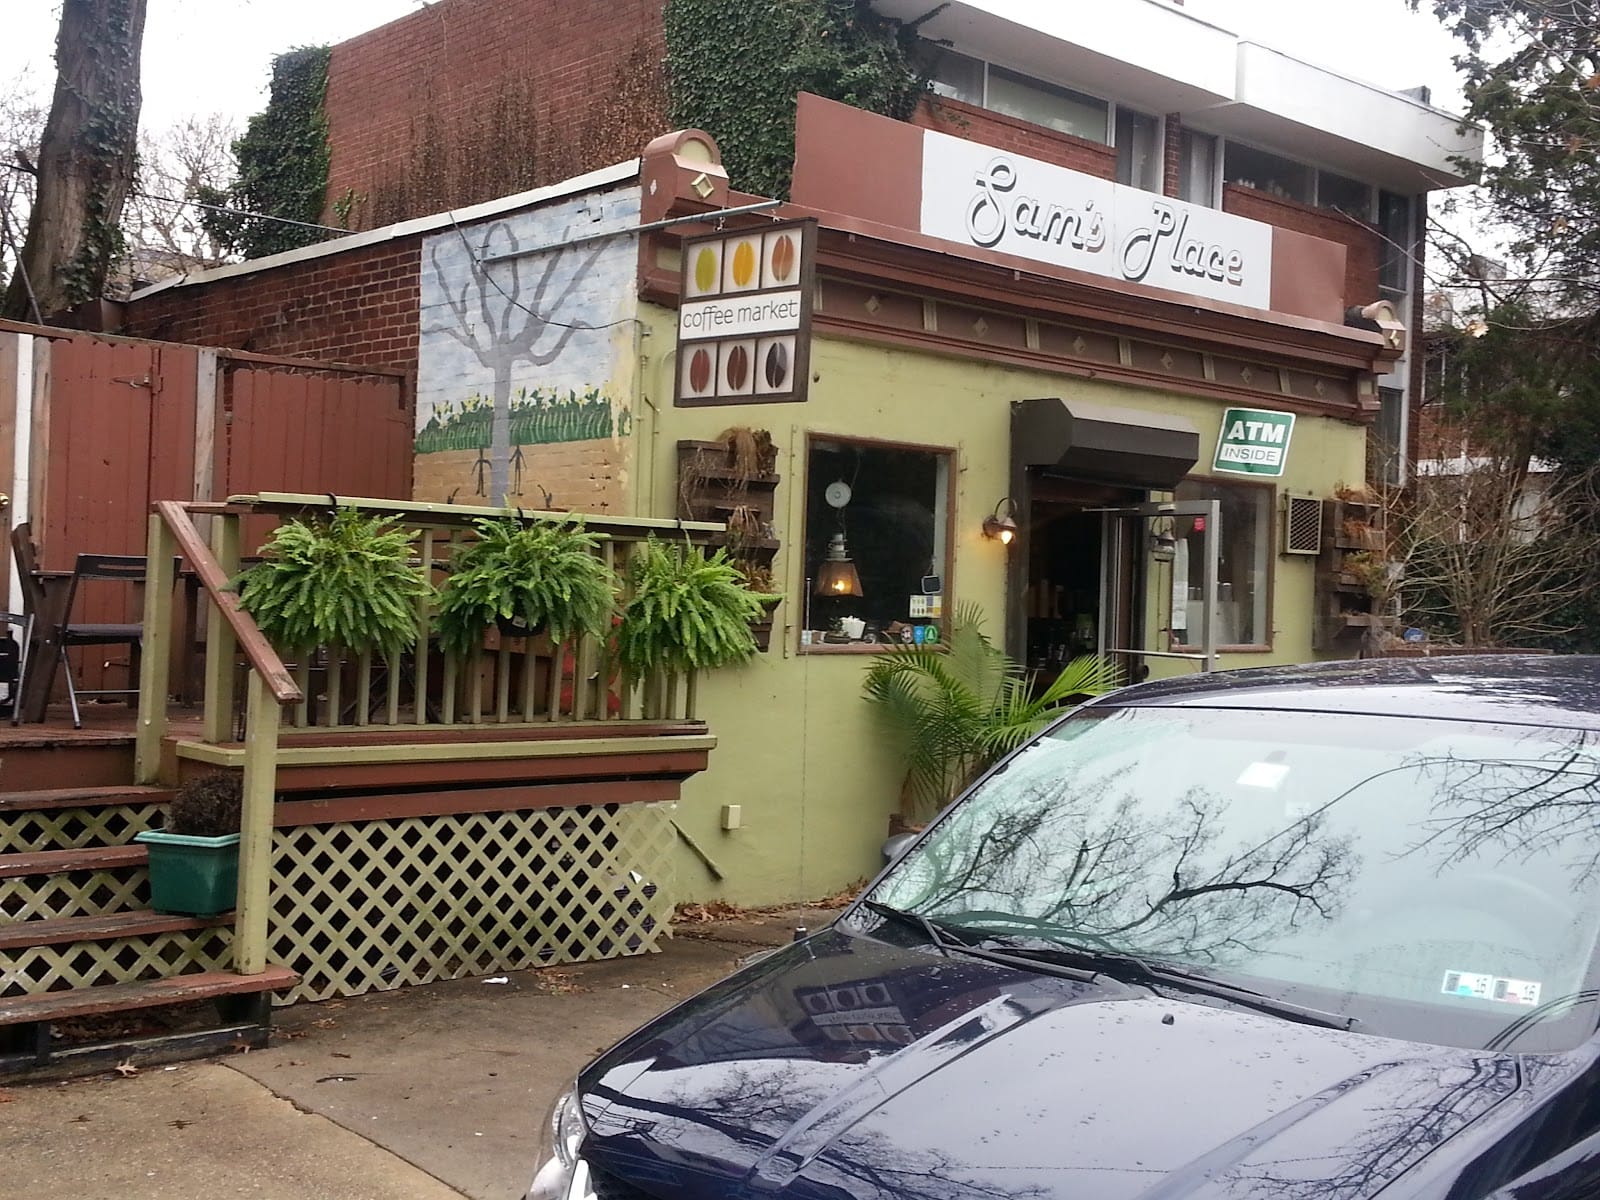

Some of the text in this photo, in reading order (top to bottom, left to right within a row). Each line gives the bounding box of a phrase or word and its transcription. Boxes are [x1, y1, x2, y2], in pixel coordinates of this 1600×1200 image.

[965, 156, 1244, 285] Sam's Place
[683, 299, 798, 332] coffee market
[1226, 420, 1286, 444] ATM
[1224, 447, 1278, 462] INSIDE
